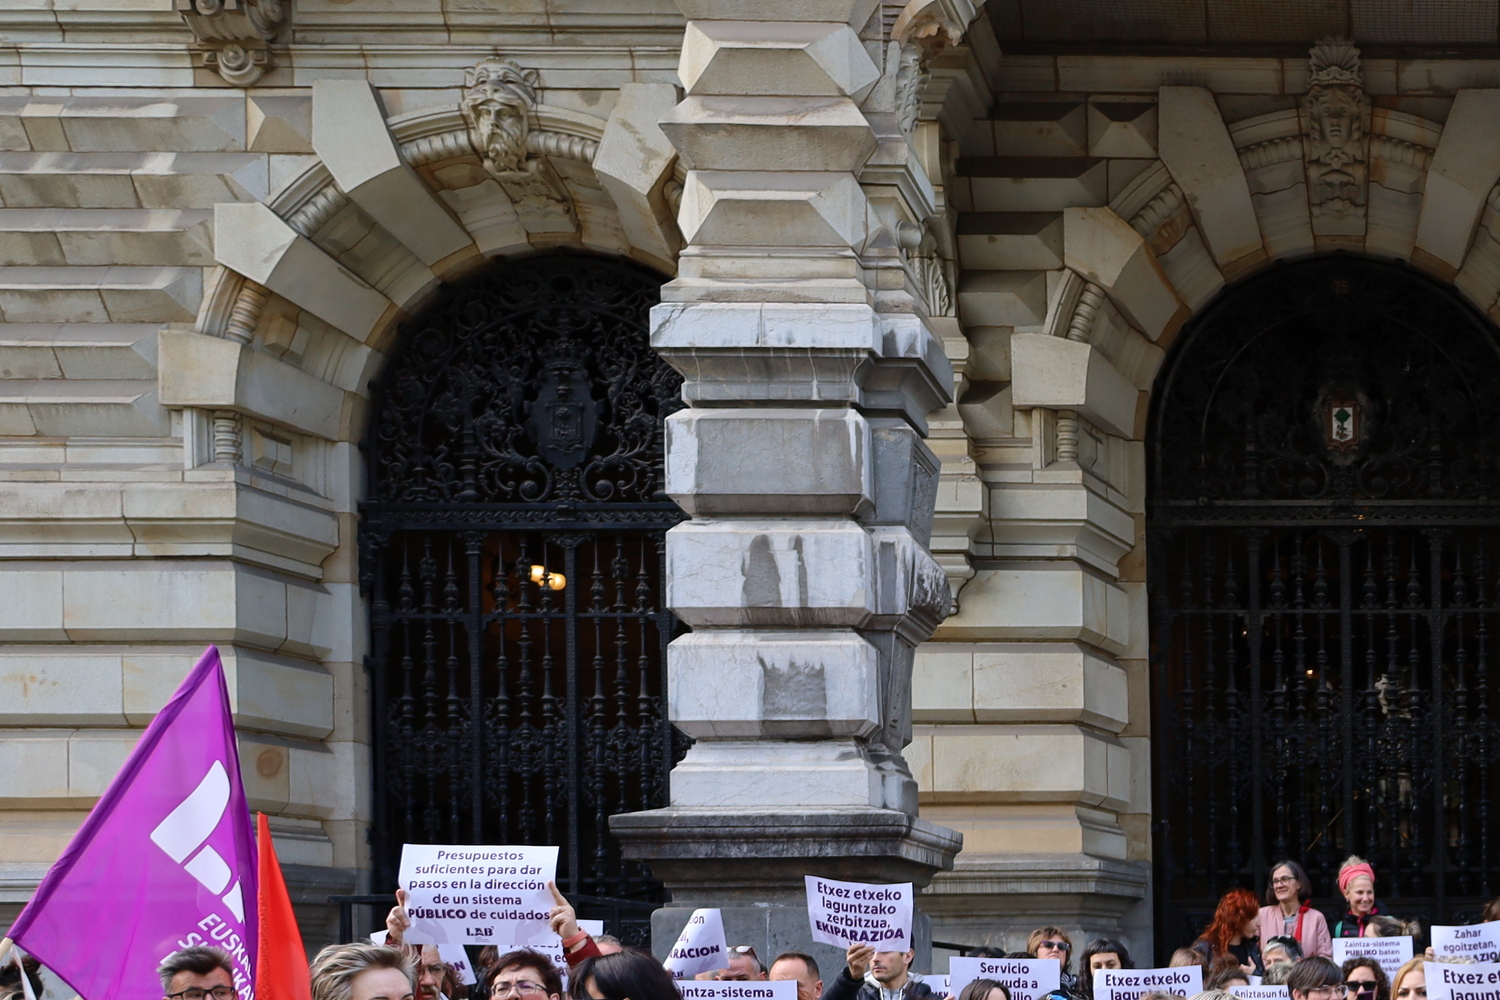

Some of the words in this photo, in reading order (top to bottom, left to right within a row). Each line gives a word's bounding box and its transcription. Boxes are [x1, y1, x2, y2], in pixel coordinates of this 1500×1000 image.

[437, 850, 524, 862] Presupuestos
[415, 864, 485, 875] suficientes
[487, 866, 517, 876] para
[520, 865, 542, 875] dar
[409, 880, 448, 891] pasos
[451, 880, 467, 889] en
[470, 879, 481, 889] la
[484, 878, 545, 890] dirección
[817, 881, 851, 898] Etxez
[853, 888, 902, 901] etxeko
[432, 893, 450, 904] de
[453, 895, 469, 905] un
[472, 894, 522, 905] sistema
[822, 896, 896, 915] laguntzako
[408, 908, 467, 919] PÚBLICO
[470, 909, 487, 919] de
[490, 909, 551, 920] cuidados
[826, 913, 890, 929] zerbitzua,
[466, 926, 494, 936] LAB
[815, 920, 904, 942] EKIPARAZIOA
[1454, 929, 1481, 939] Zahar
[1443, 941, 1497, 953] egoitzetan,
[980, 962, 1030, 974] Servicio
[1105, 974, 1140, 986] Etxez
[1143, 972, 1190, 985] etxeko
[1443, 969, 1483, 984] Etxez
[1031, 980, 1038, 988] a
[681, 987, 774, 998] intza-sistema
[1234, 989, 1277, 999] Aniztasun
